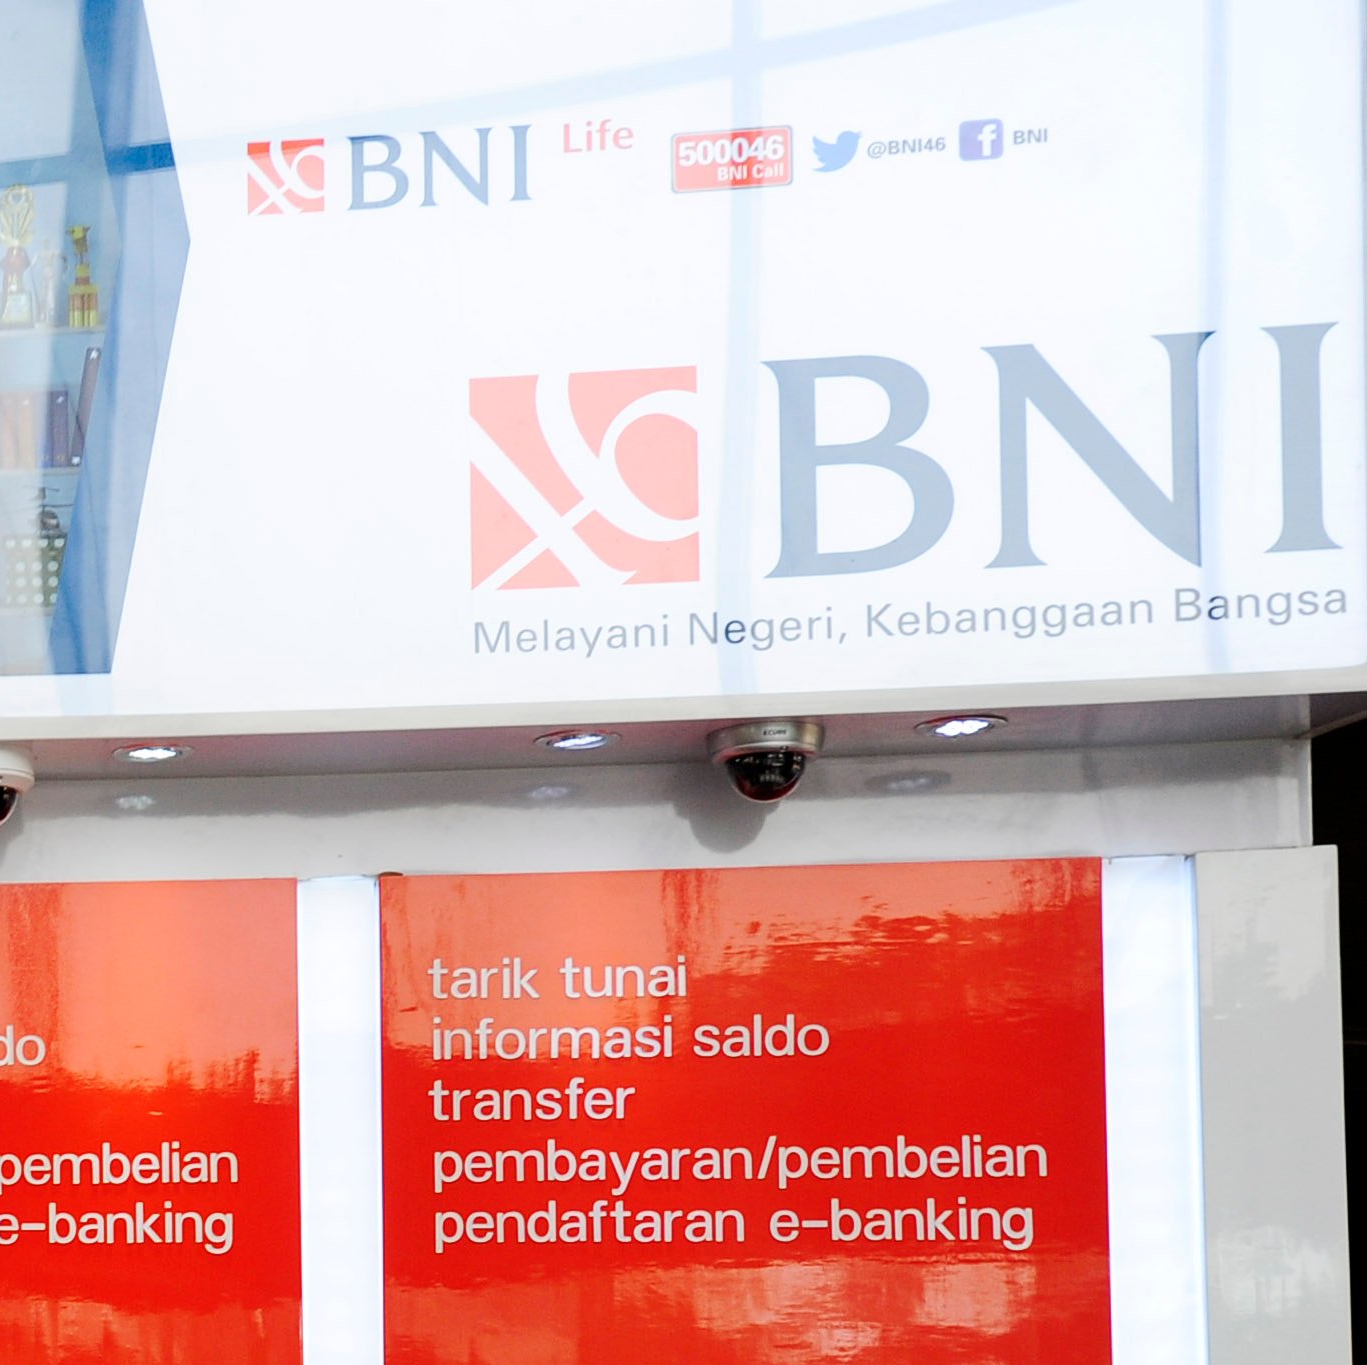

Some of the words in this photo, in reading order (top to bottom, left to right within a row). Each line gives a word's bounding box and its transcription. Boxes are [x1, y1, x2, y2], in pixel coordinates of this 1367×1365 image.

[678, 135, 785, 166] 500046
[867, 137, 945, 159] @BNI46
[1013, 127, 1049, 147] BNI
[347, 125, 533, 212] BNI
[562, 119, 634, 154] Life
[717, 166, 747, 181] BNI
[752, 163, 784, 179] Call
[760, 322, 1343, 579] BNI
[473, 615, 671, 658] Melayani
[688, 608, 848, 652] Negeri,
[866, 597, 1153, 641] Kebanggaan
[1173, 583, 1347, 626] Bangsa
[428, 957, 539, 999] tarik
[560, 955, 688, 998] tunai
[431, 1015, 673, 1061] informasi
[693, 1014, 830, 1057] saldo
[428, 1078, 636, 1121] transfer
[433, 1135, 1048, 1196] pembayaran/pembelian
[433, 1200, 745, 1254] pendaftaran
[769, 1196, 1034, 1250] e-banking
